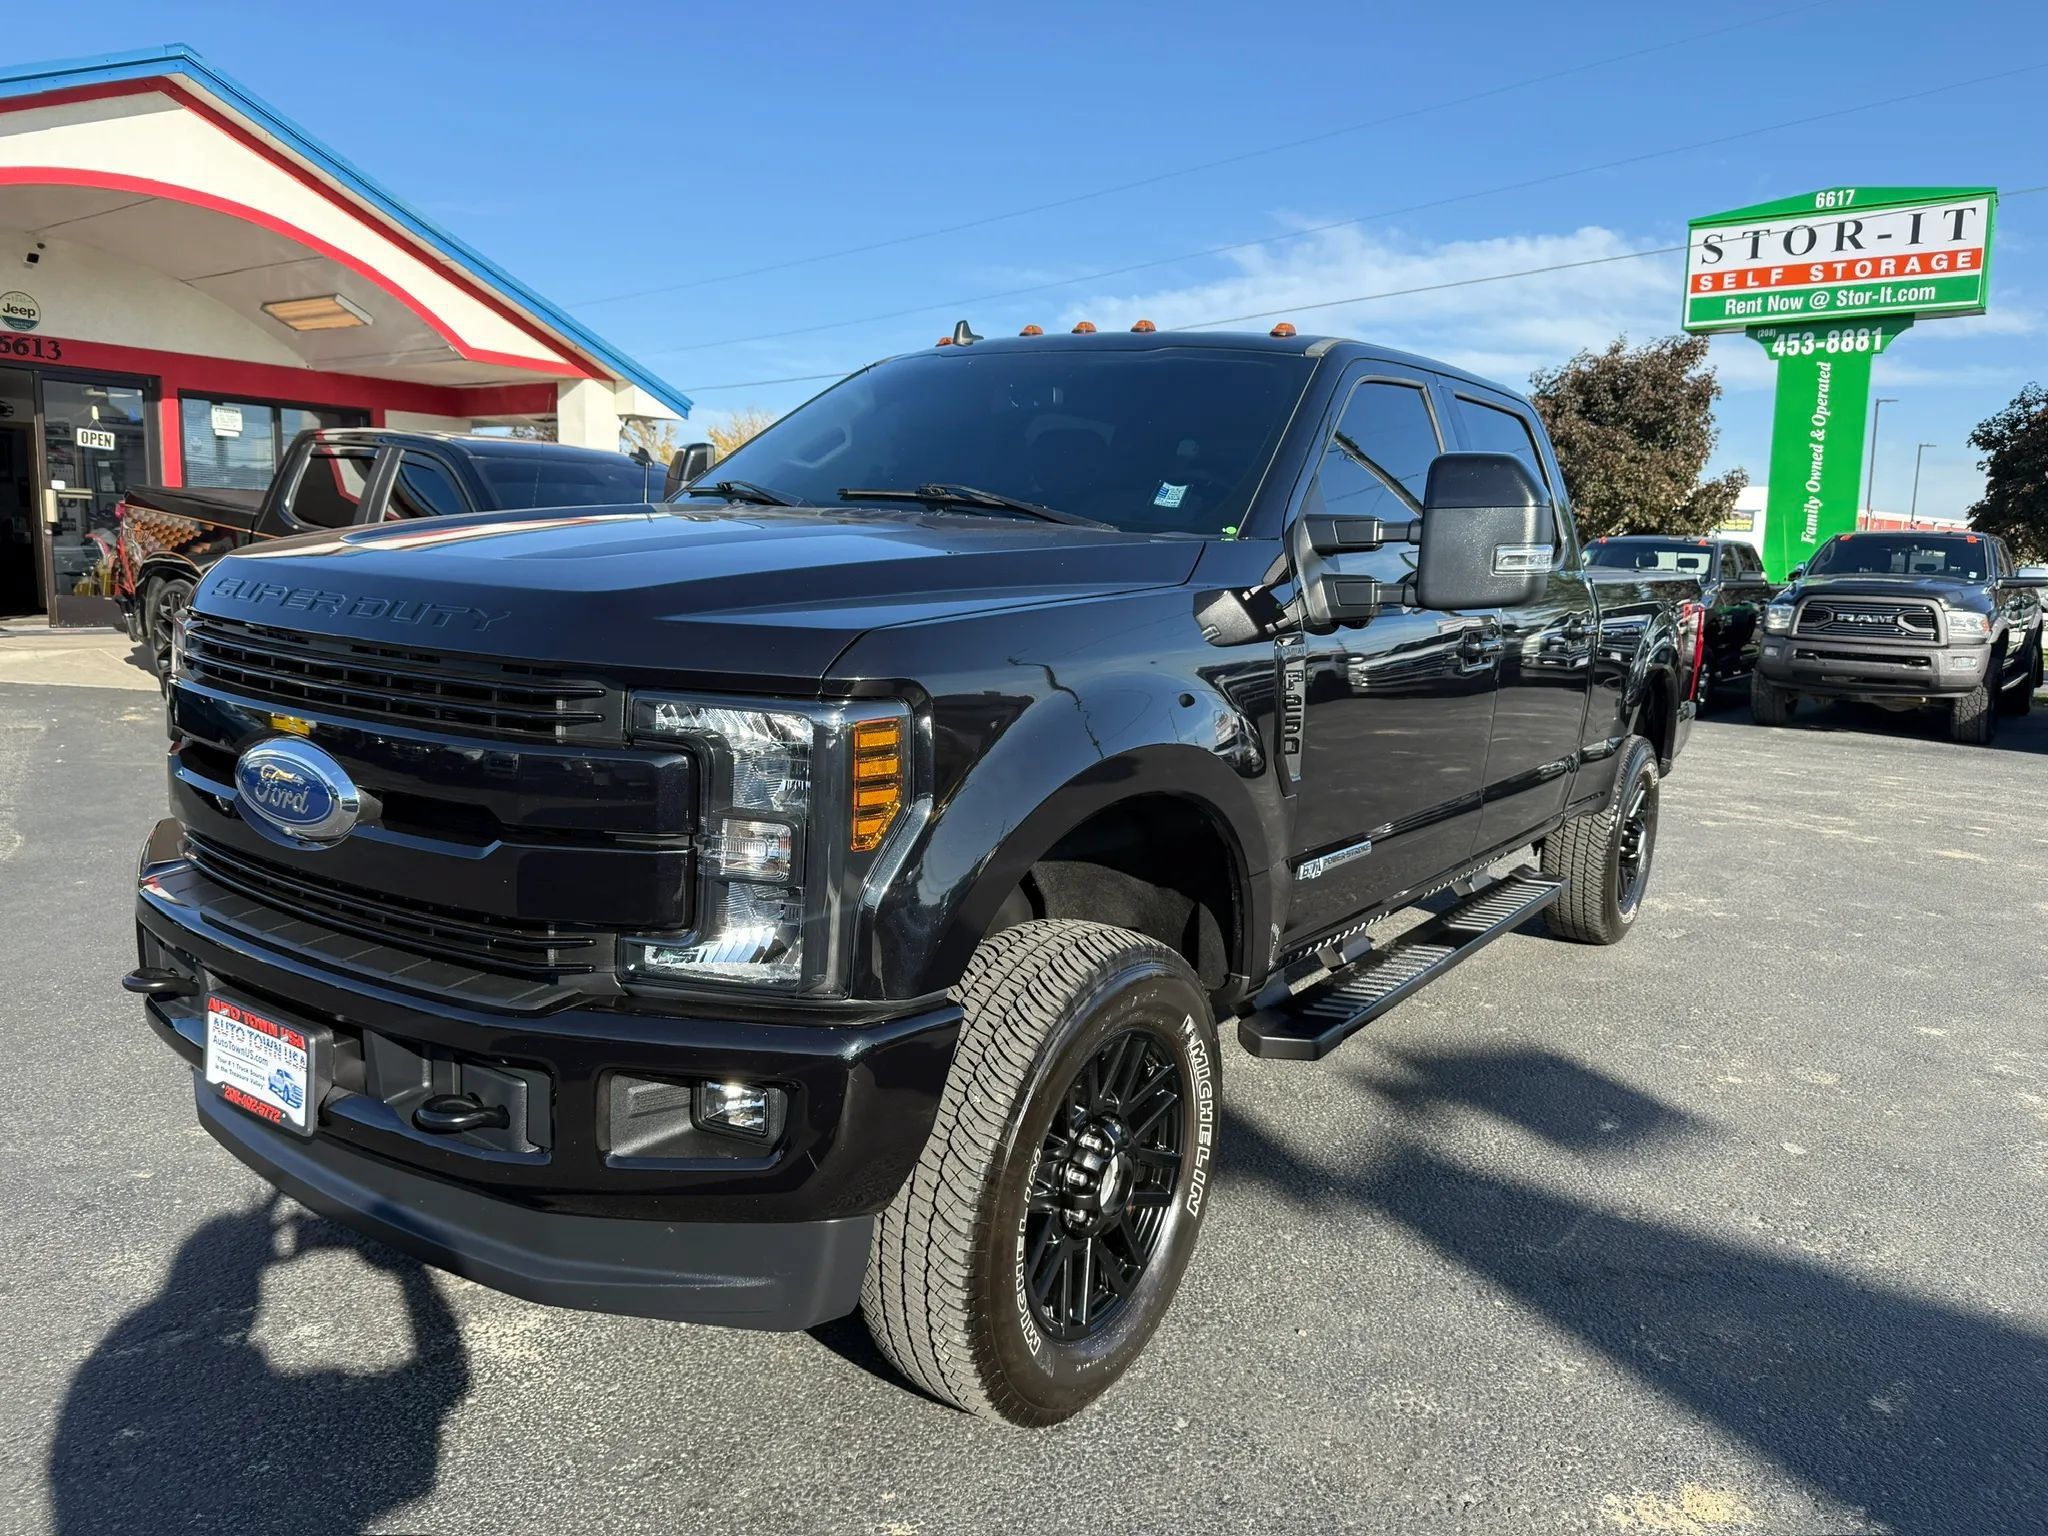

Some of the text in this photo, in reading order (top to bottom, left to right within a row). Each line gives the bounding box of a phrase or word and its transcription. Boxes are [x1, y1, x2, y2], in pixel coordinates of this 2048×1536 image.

[1815, 188, 1855, 209] 6617
[1701, 207, 1977, 265] STOR-IT
[1699, 251, 1973, 291] SELF STORAGE
[2, 303, 36, 319] Jeep
[1725, 286, 1936, 315] Rent Now @ Stor-It.com
[1772, 327, 1882, 356] 453-8881
[80, 430, 112, 447] OPEN
[1801, 361, 1832, 544] Family Owned & Operated
[211, 577, 512, 631] SUPER DUTY
[1836, 613, 1896, 624] RAM
[254, 764, 311, 815] Ford
[242, 1011, 278, 1037] TOWN
[1186, 1039, 1212, 1219] MICHELIN
[1016, 1147, 1042, 1357] MICHELIN
